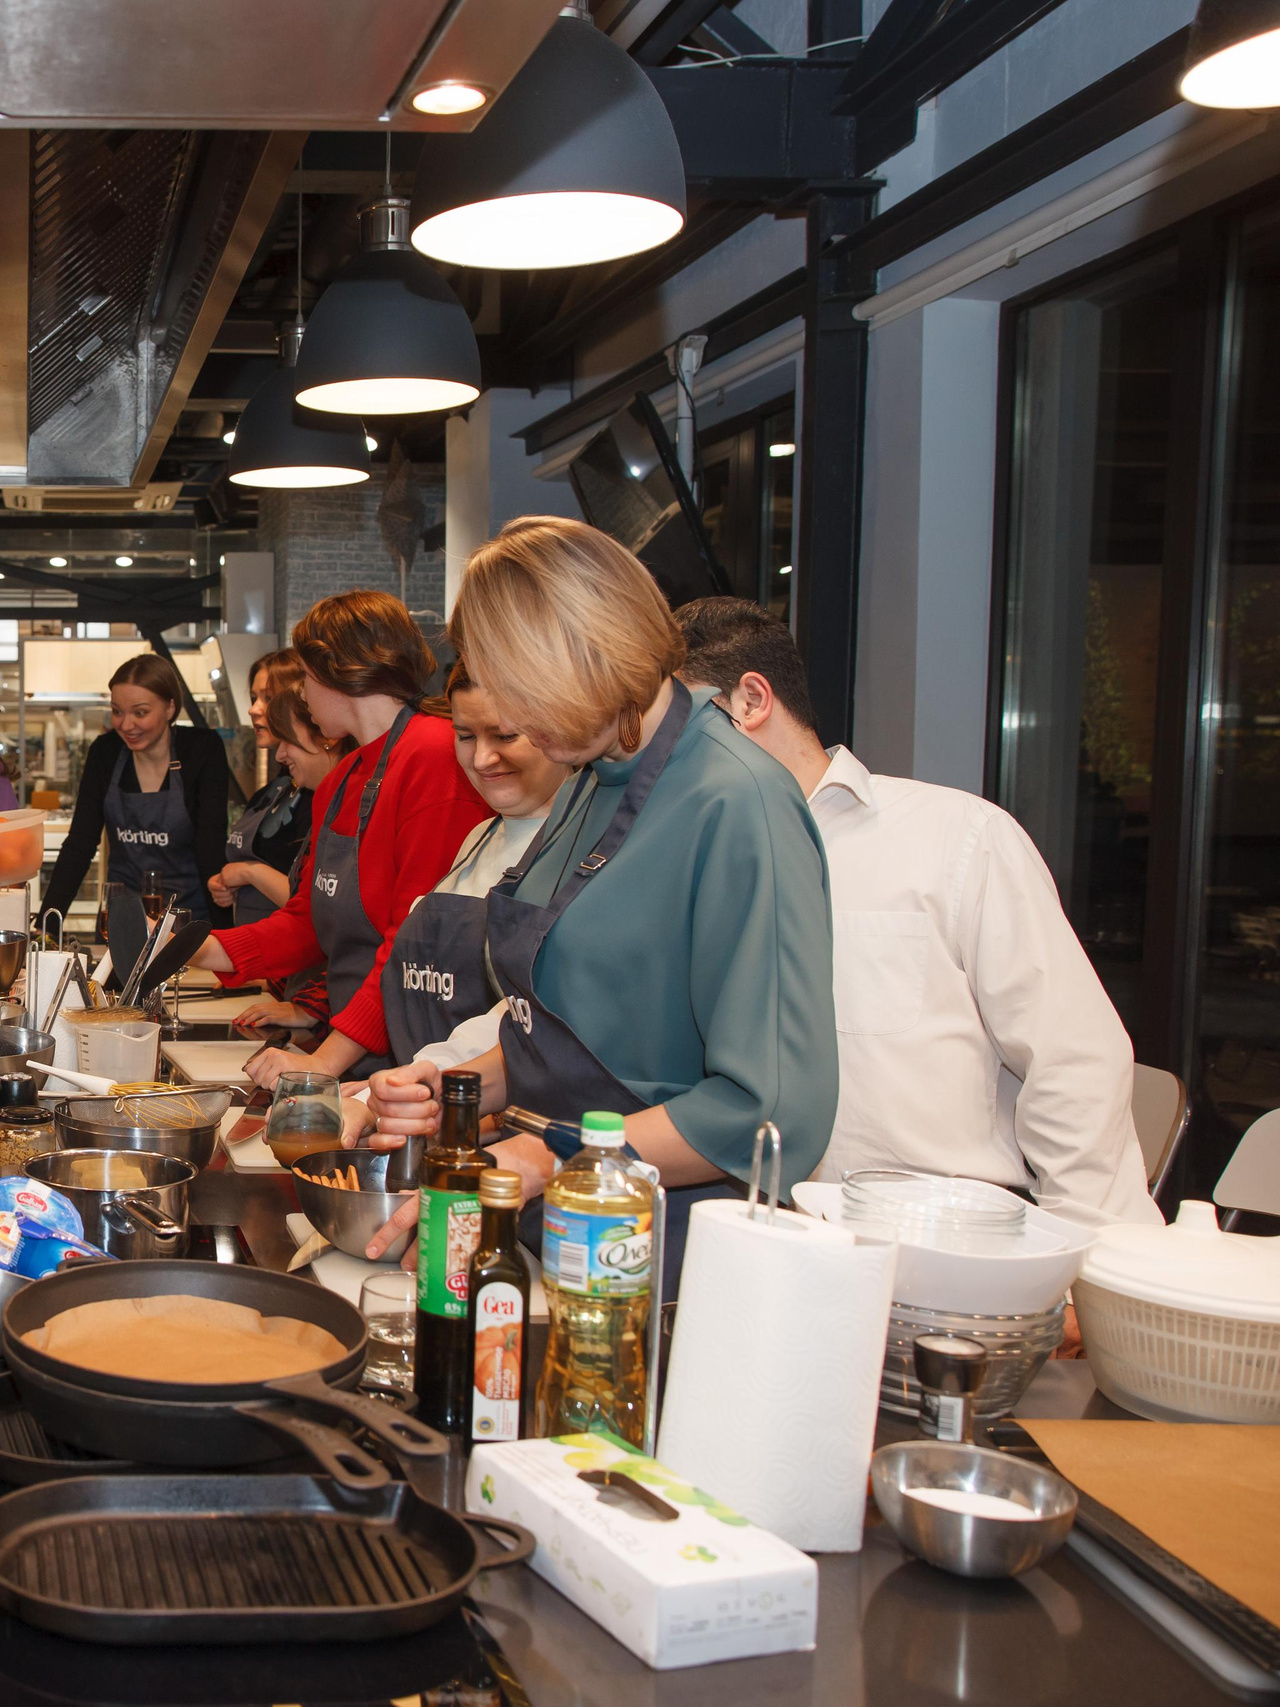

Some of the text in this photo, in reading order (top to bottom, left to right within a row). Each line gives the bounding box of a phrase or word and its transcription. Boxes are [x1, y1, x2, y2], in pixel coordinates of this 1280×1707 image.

[116, 826, 169, 846] körting
[402, 961, 454, 1001] körting
[483, 1296, 515, 1316] Gea
